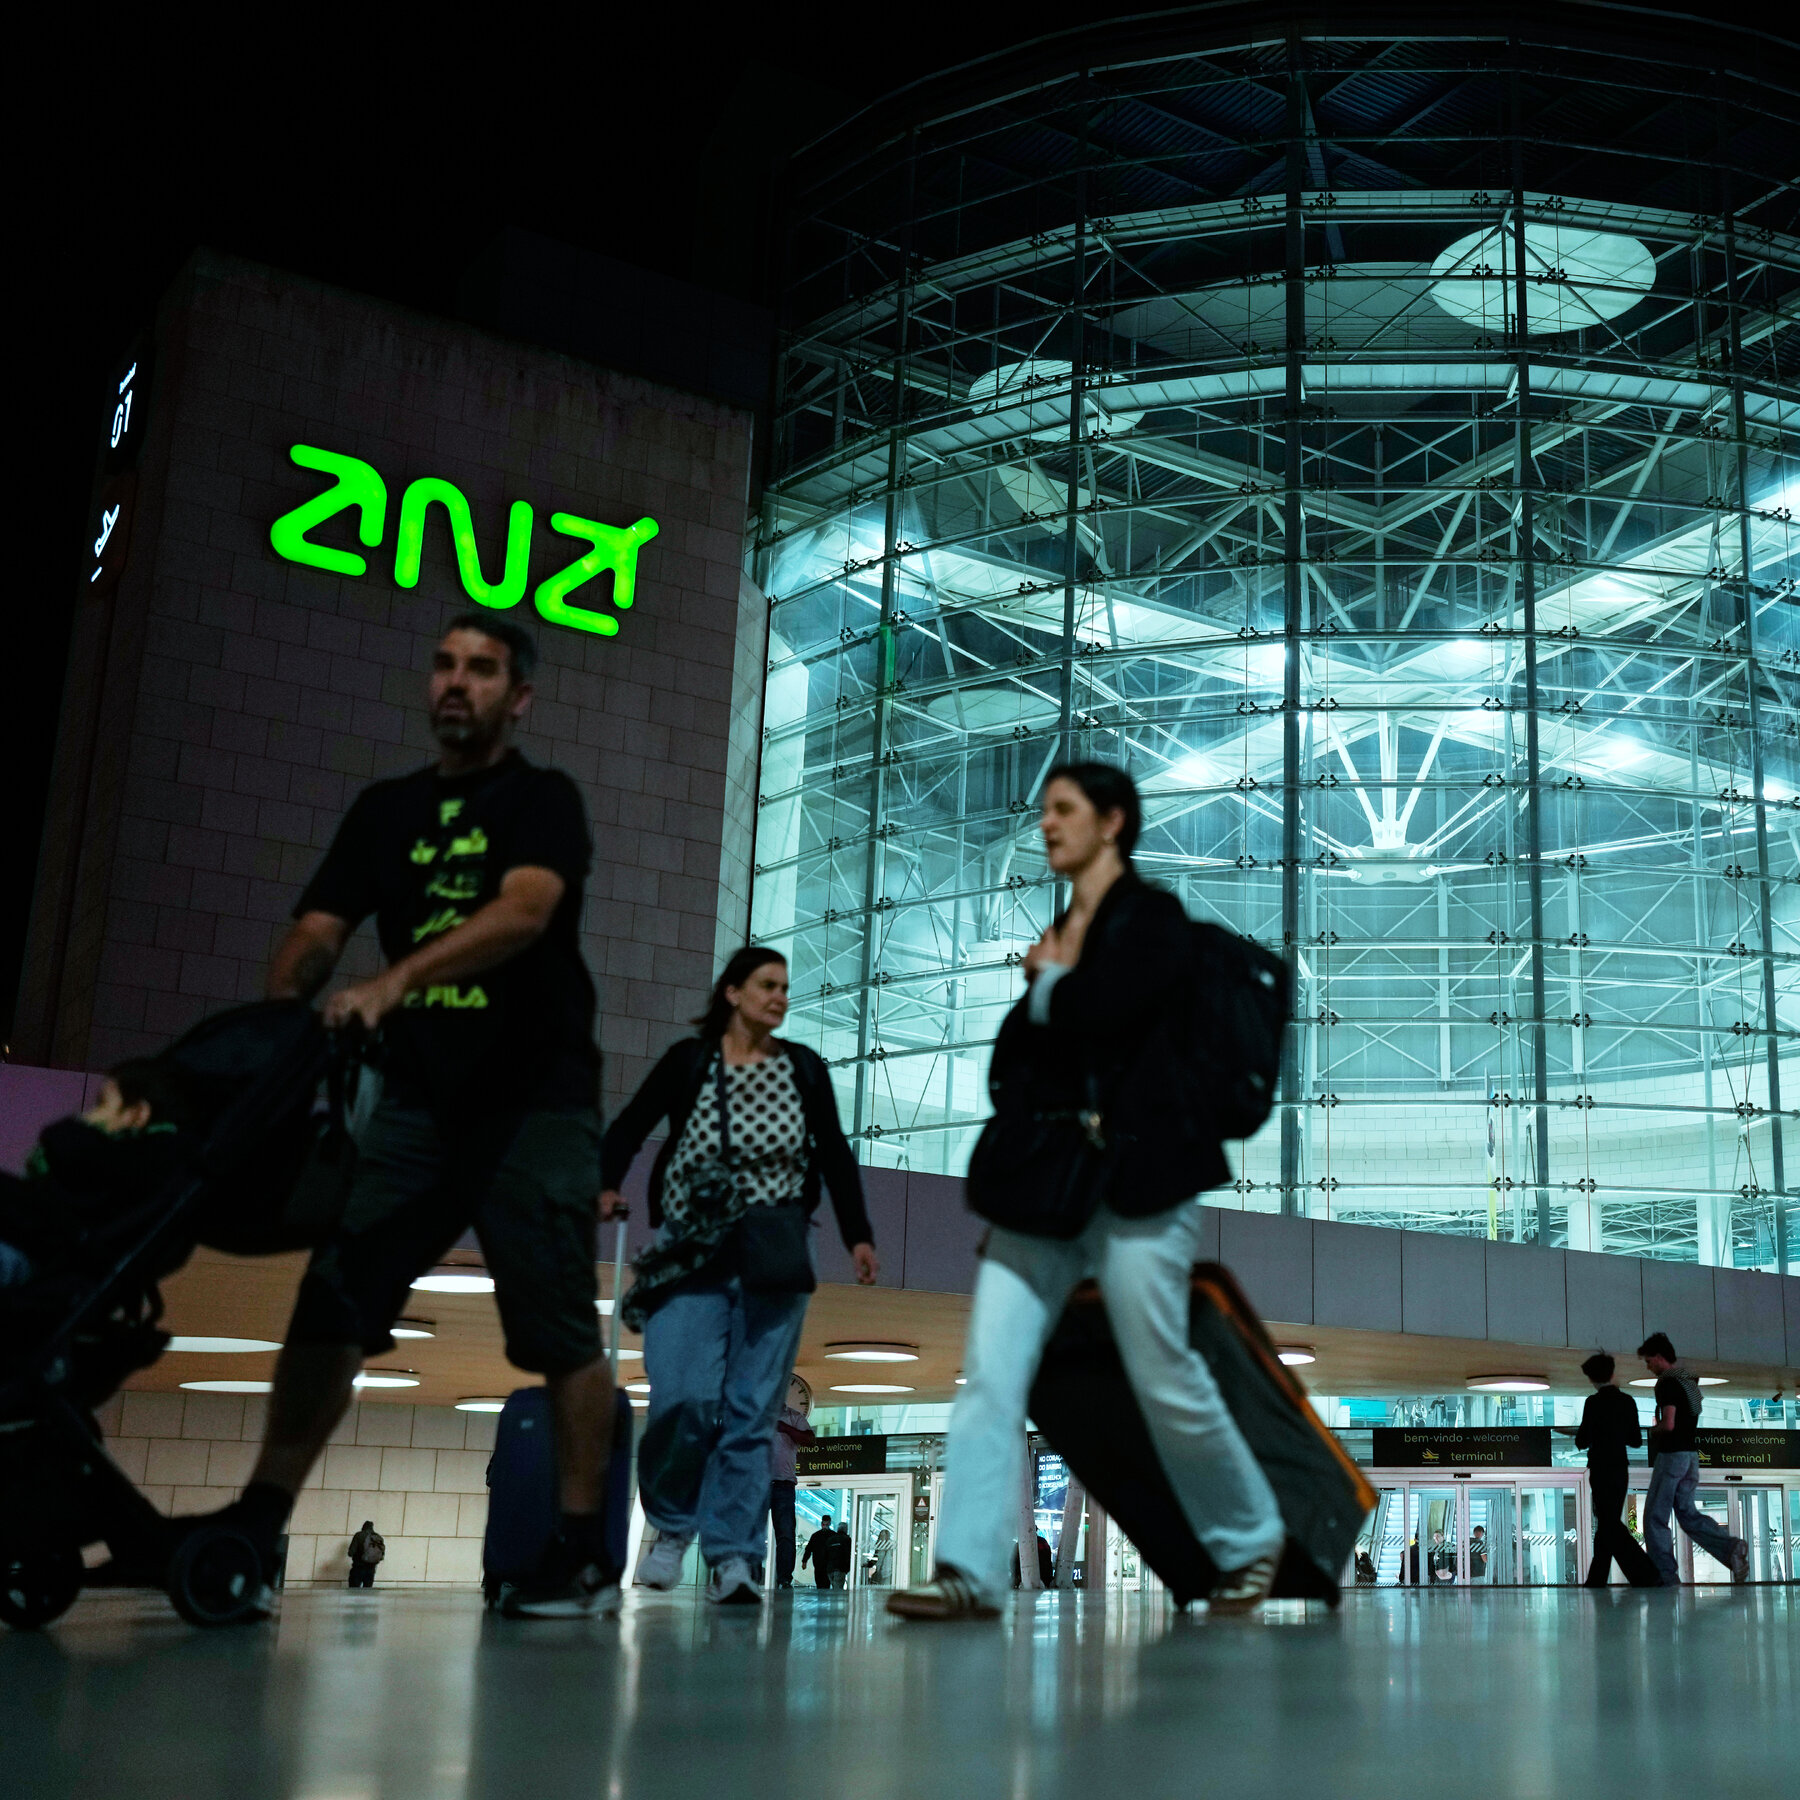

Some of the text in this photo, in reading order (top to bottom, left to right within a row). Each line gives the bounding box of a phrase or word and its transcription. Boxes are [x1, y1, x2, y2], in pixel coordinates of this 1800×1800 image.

[425, 985, 489, 1009] FILA
[1404, 1433, 1463, 1443] bem-vindo
[1472, 1433, 1520, 1442] welcome
[1741, 1435, 1786, 1445] welcome
[826, 1442, 863, 1452] welcome
[1450, 1451, 1497, 1461] terminal
[1721, 1453, 1765, 1463] terminal
[808, 1460, 844, 1471] terminal
